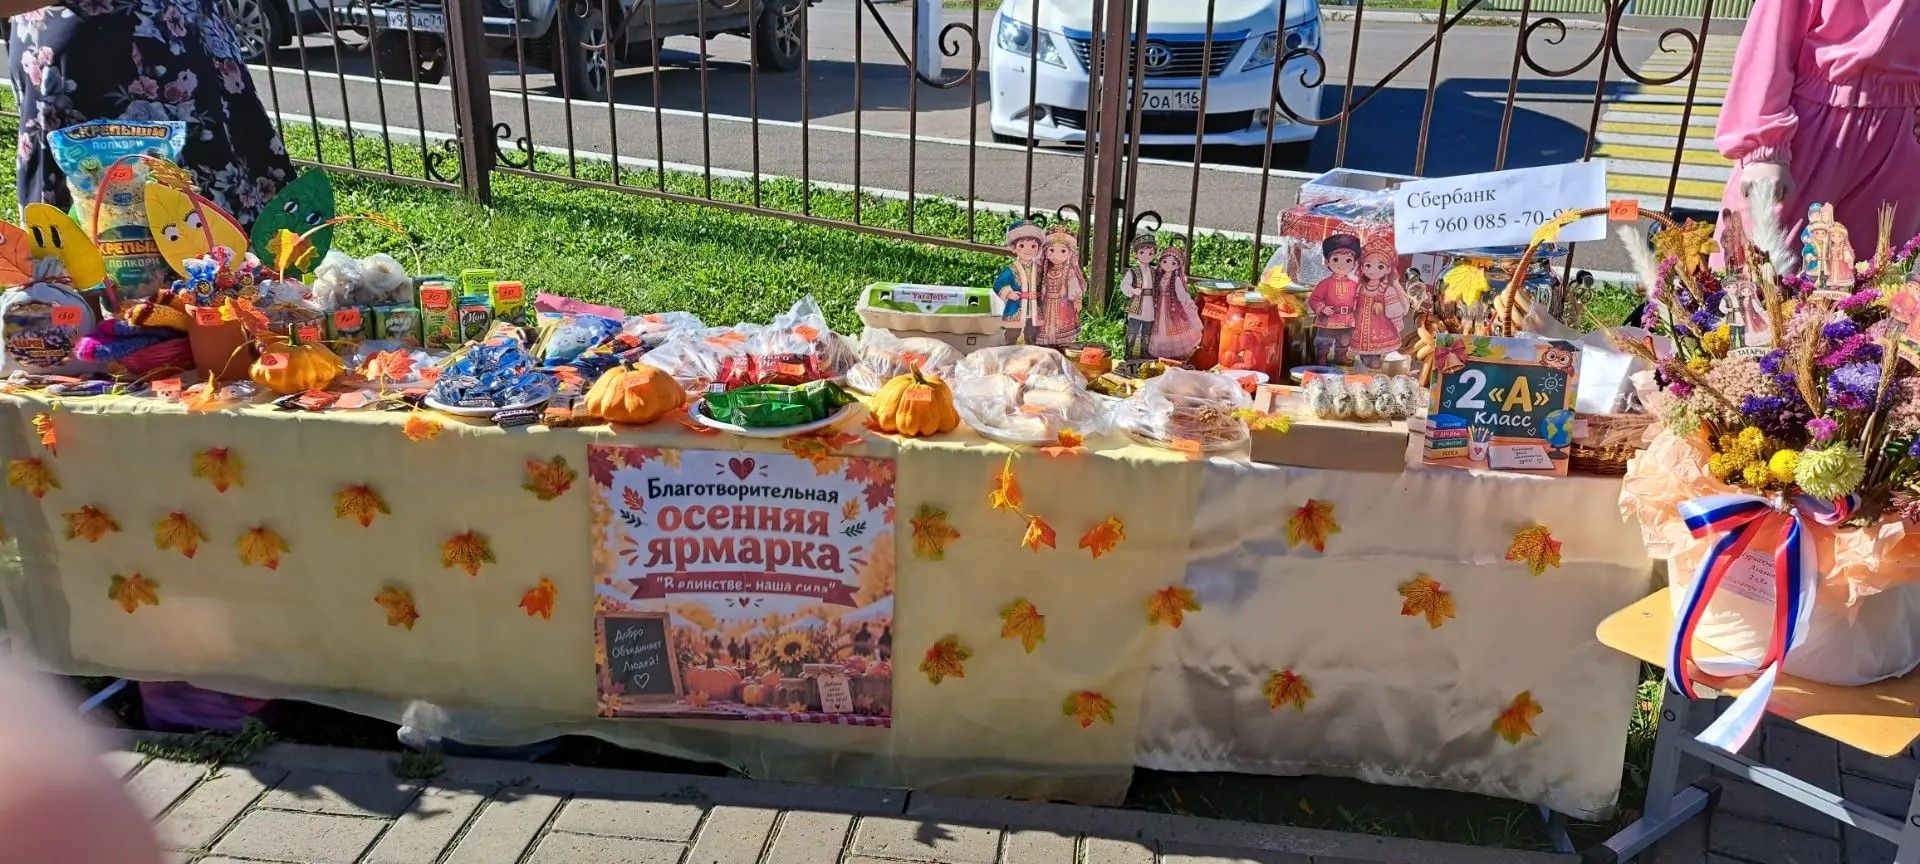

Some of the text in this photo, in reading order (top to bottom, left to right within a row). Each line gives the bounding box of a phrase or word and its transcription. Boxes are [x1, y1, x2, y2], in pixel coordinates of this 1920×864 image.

[1175, 91, 1200, 104] 116
[1407, 187, 1497, 209] Сбербанк
[1408, 219, 1429, 235] +7
[1435, 216, 1468, 233] 960
[1474, 213, 1507, 230] 085
[1455, 368, 1550, 413] 2 «А»
[1474, 411, 1532, 427] класс
[647, 477, 840, 504] Благотворительная
[656, 503, 830, 537] осенняя
[642, 535, 845, 573] ярмарка
[755, 579, 792, 593] наша
